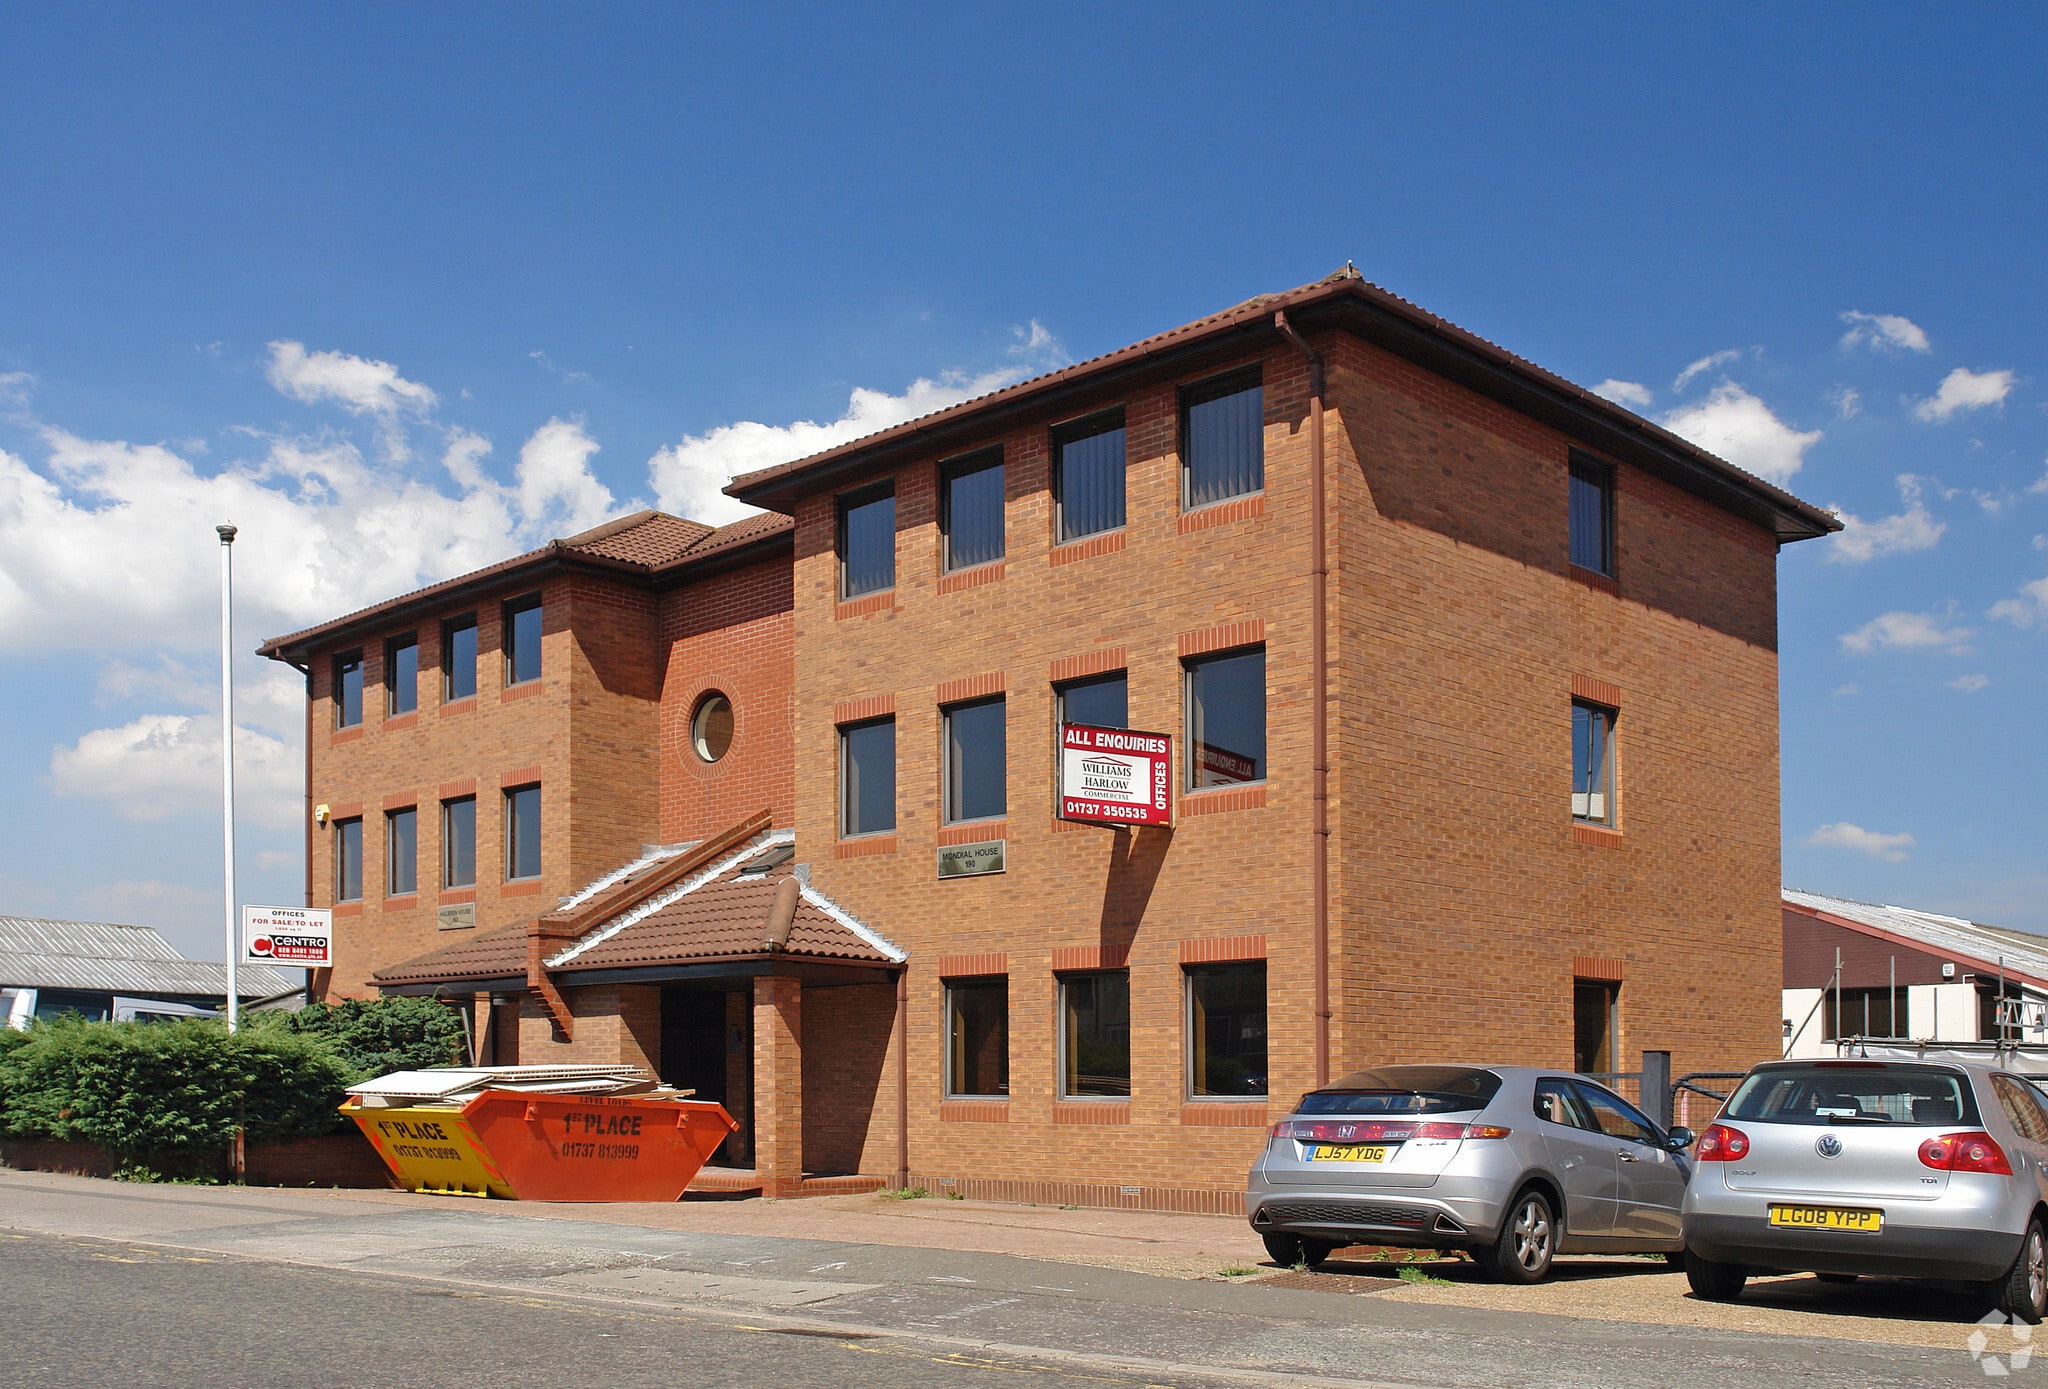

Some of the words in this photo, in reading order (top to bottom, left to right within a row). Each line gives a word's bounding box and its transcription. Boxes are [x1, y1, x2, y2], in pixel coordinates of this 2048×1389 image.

[1066, 729, 1092, 746] ALL
[1095, 732, 1166, 754] ENQUIRIES
[1082, 762, 1132, 777] WILLIAMS
[1084, 776, 1129, 790] HARLOW
[1154, 761, 1167, 810] OFFICES
[1083, 790, 1130, 801] COMMERCIAL
[1066, 801, 1100, 815] 01737
[1103, 805, 1148, 819] 350535
[942, 850, 973, 861] MONDIAL
[974, 847, 999, 857] HOUSE
[392, 1121, 449, 1140] PLACE
[584, 1113, 642, 1135] PLACE
[392, 1144, 424, 1158] 01737
[562, 1142, 595, 1158] 01737
[598, 1143, 639, 1160] 813999
[1314, 1147, 1353, 1159] LJ57
[1356, 1148, 1384, 1160] YDG
[1779, 1207, 1828, 1225] LG08
[1833, 1210, 1871, 1227] YPP
